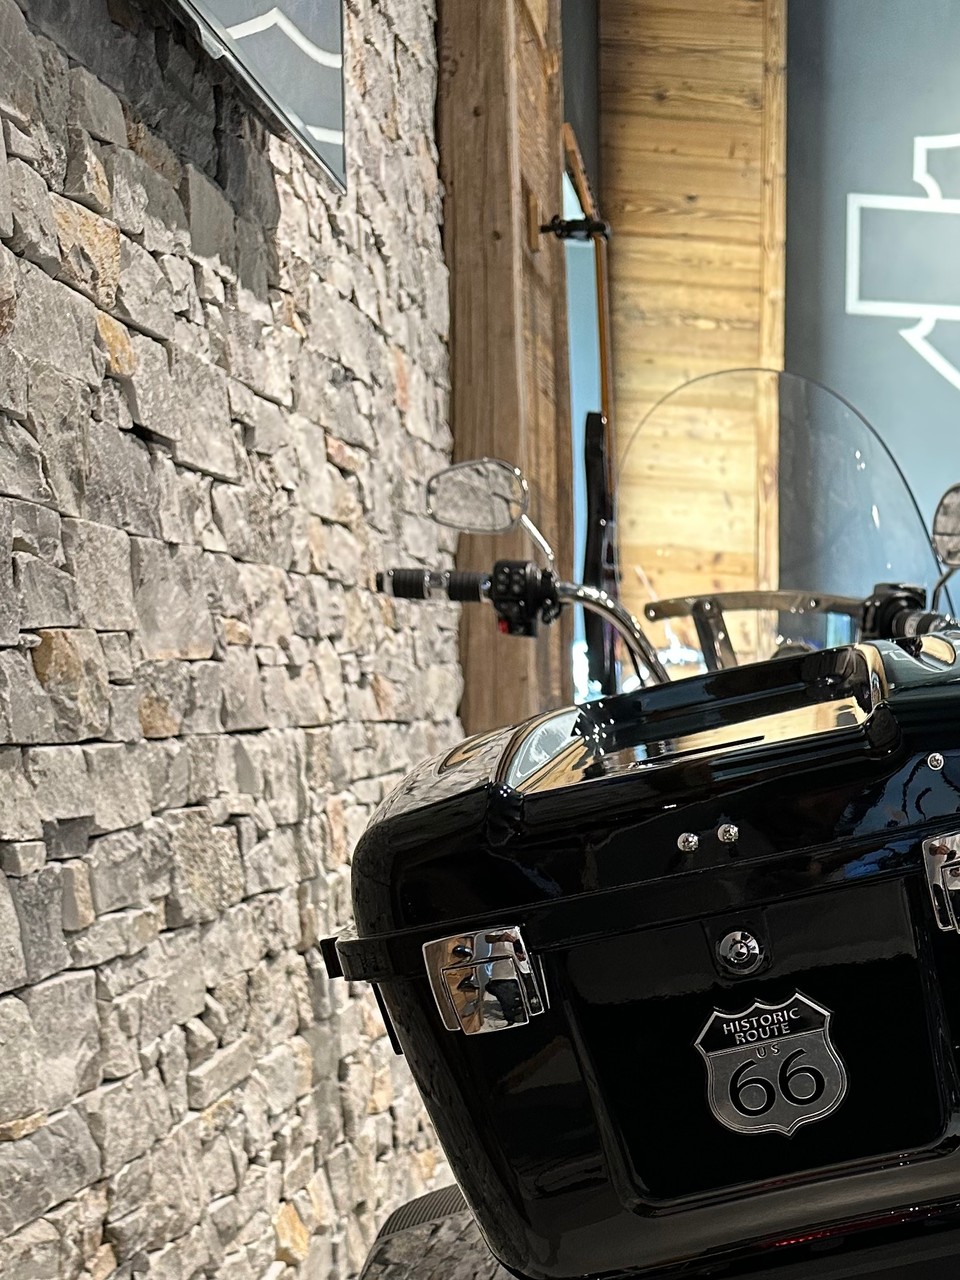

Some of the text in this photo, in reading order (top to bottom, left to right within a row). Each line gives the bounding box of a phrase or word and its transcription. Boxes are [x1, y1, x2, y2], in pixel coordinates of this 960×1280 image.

[723, 1008, 800, 1035] HISTORIC
[735, 1023, 790, 1044] ROUTE
[728, 1048, 826, 1117] 66
